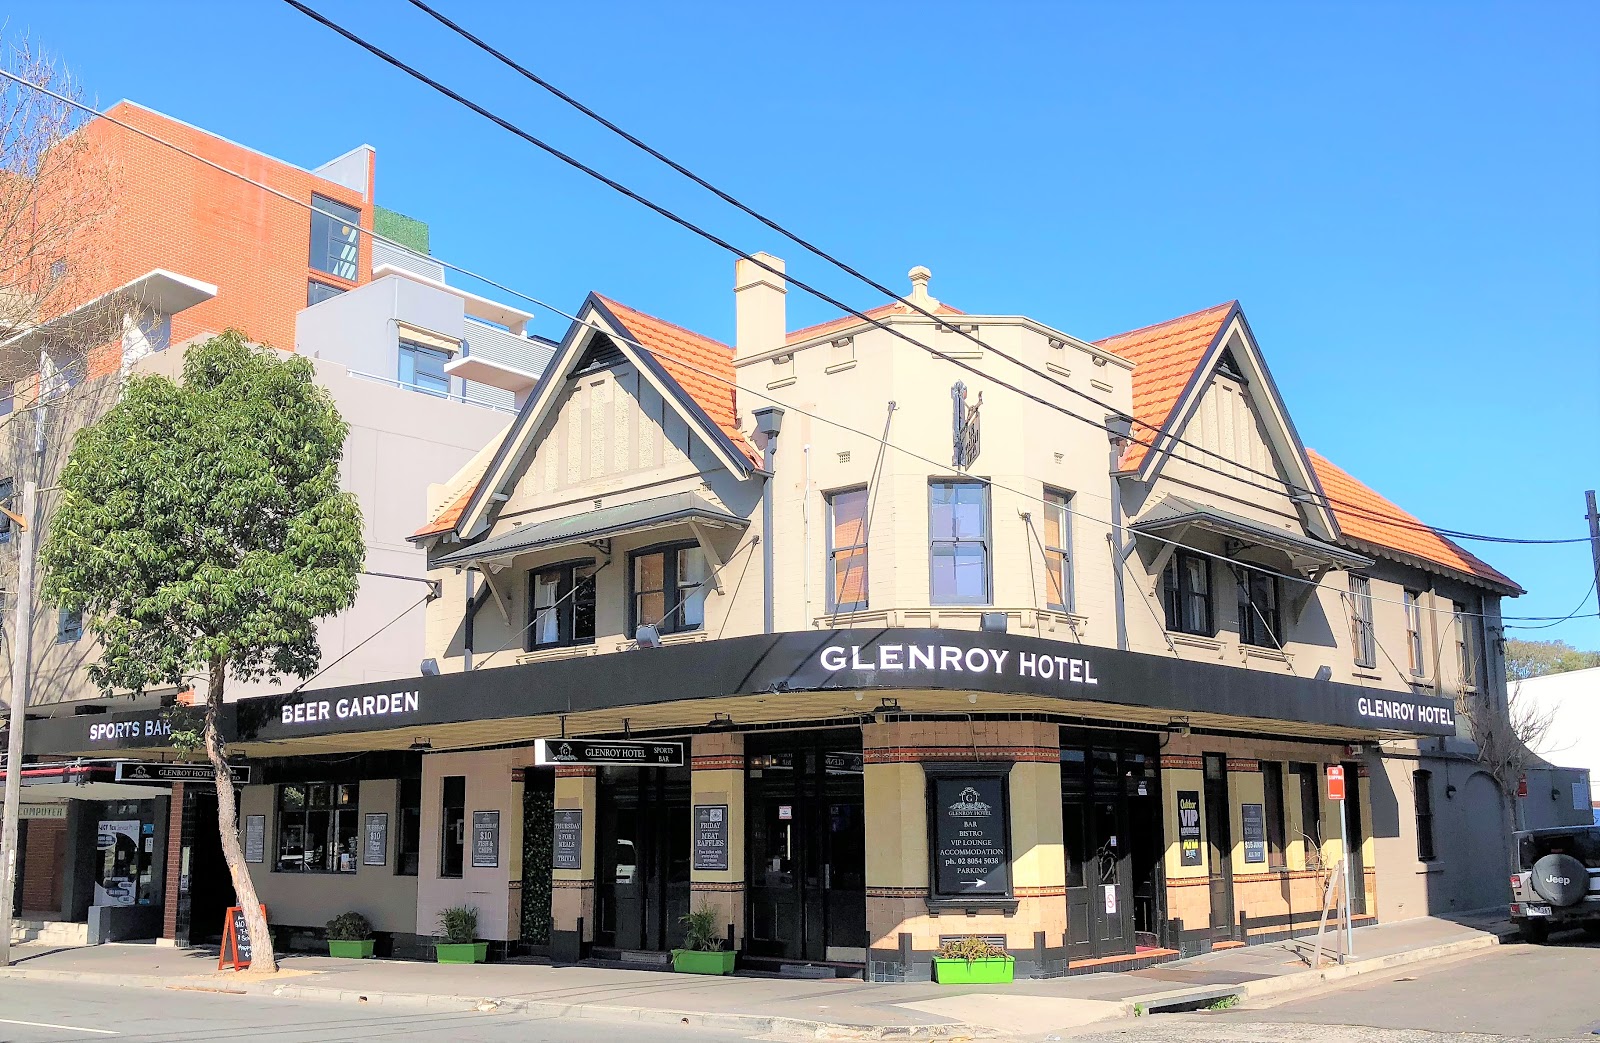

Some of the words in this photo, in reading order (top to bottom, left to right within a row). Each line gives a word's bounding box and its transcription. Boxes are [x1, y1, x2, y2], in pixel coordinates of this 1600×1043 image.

[820, 645, 1010, 674] GLENROY
[1019, 650, 1098, 685] HOTEL
[281, 701, 330, 723] BEER
[335, 690, 419, 718] GARDEN
[1358, 697, 1415, 721] GLENROY
[1417, 705, 1454, 725] HOTEL
[89, 721, 140, 740] SPORTS
[144, 719, 172, 736] BAR
[585, 748, 621, 757] GLENROY
[622, 749, 646, 758] HOTEL
[658, 755, 670, 763] BAR
[158, 769, 192, 777] GLENROY
[1180, 809, 1198, 827] VIP
[370, 831, 381, 840] $10
[479, 831, 492, 840] $10
[701, 832, 719, 840] MEAT
[697, 839, 724, 847] RAFFLES
[478, 846, 493, 854] CHIPS
[940, 848, 1004, 856] ACCOMMODATION
[557, 854, 576, 862] TRIVIA
[957, 857, 966, 865] 02
[967, 857, 982, 865] 8054
[983, 857, 999, 865] 5038
[1545, 874, 1571, 886] Jeep
